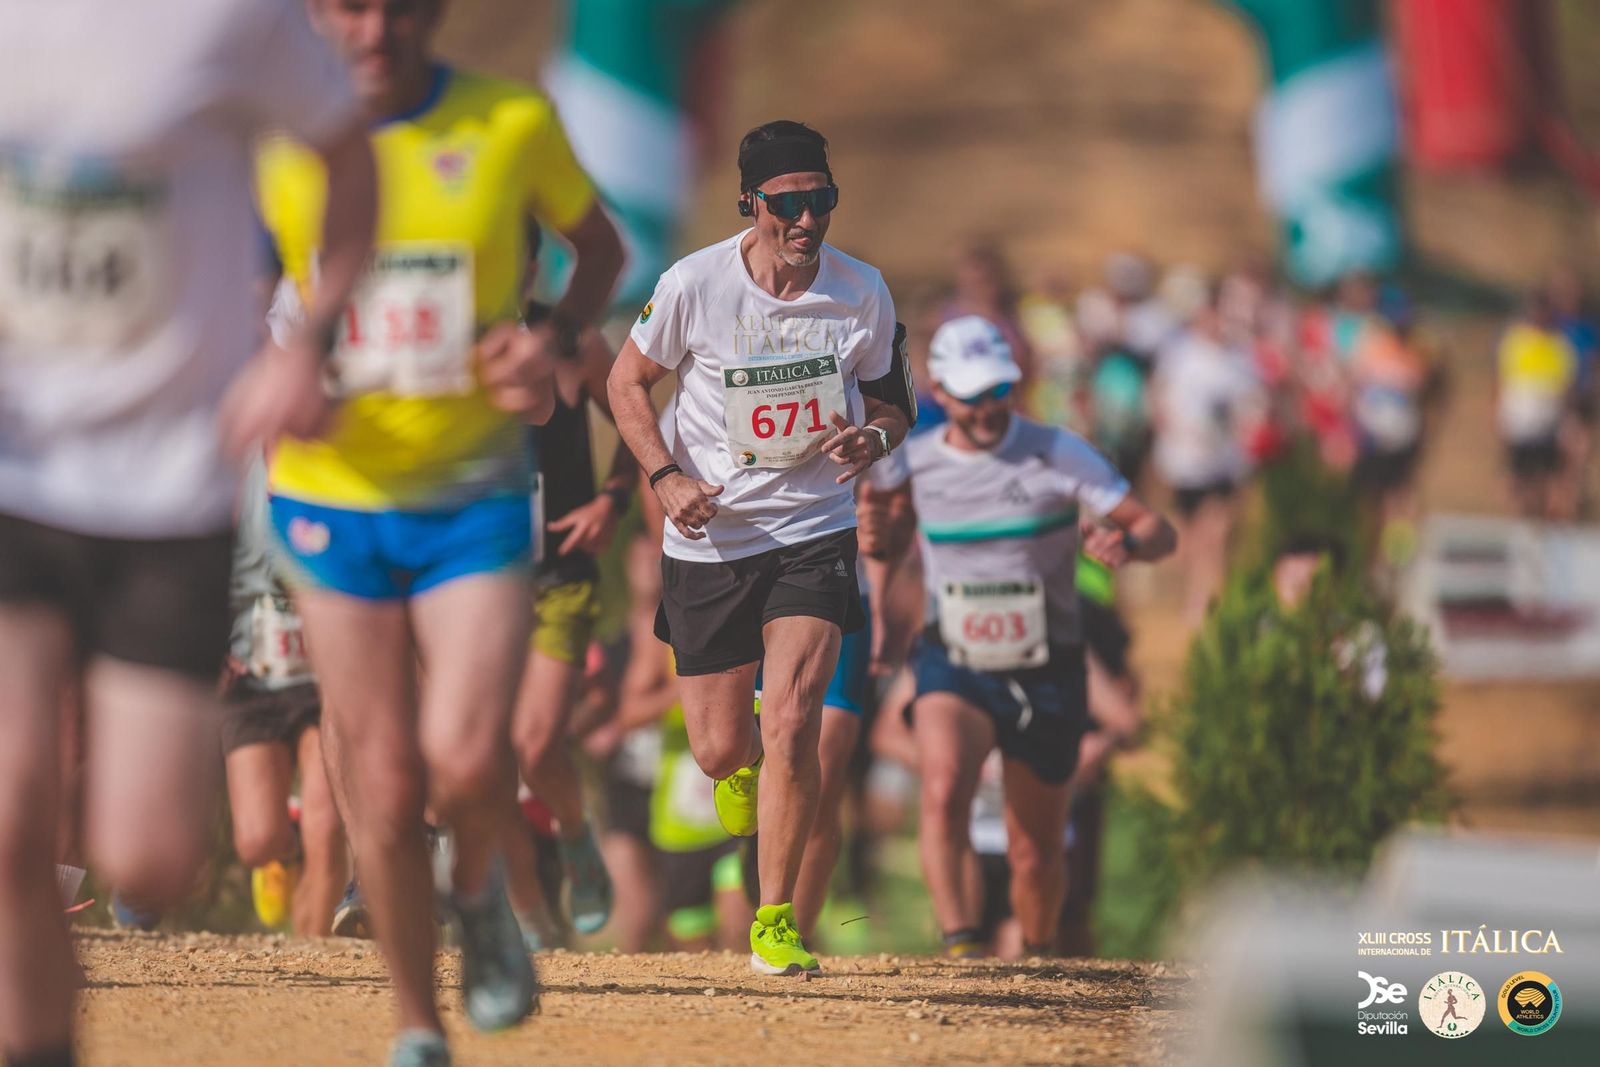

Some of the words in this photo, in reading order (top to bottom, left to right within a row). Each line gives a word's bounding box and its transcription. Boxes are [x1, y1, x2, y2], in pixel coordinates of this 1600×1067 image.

[735, 314, 783, 331] XLIII
[733, 330, 837, 355] ITÁLICA
[756, 364, 811, 383] ITÁLICA
[760, 386, 785, 394] ANTONIO
[766, 390, 806, 399] INDEPENDIENTE
[751, 397, 828, 439] 671
[962, 611, 1027, 641] 603
